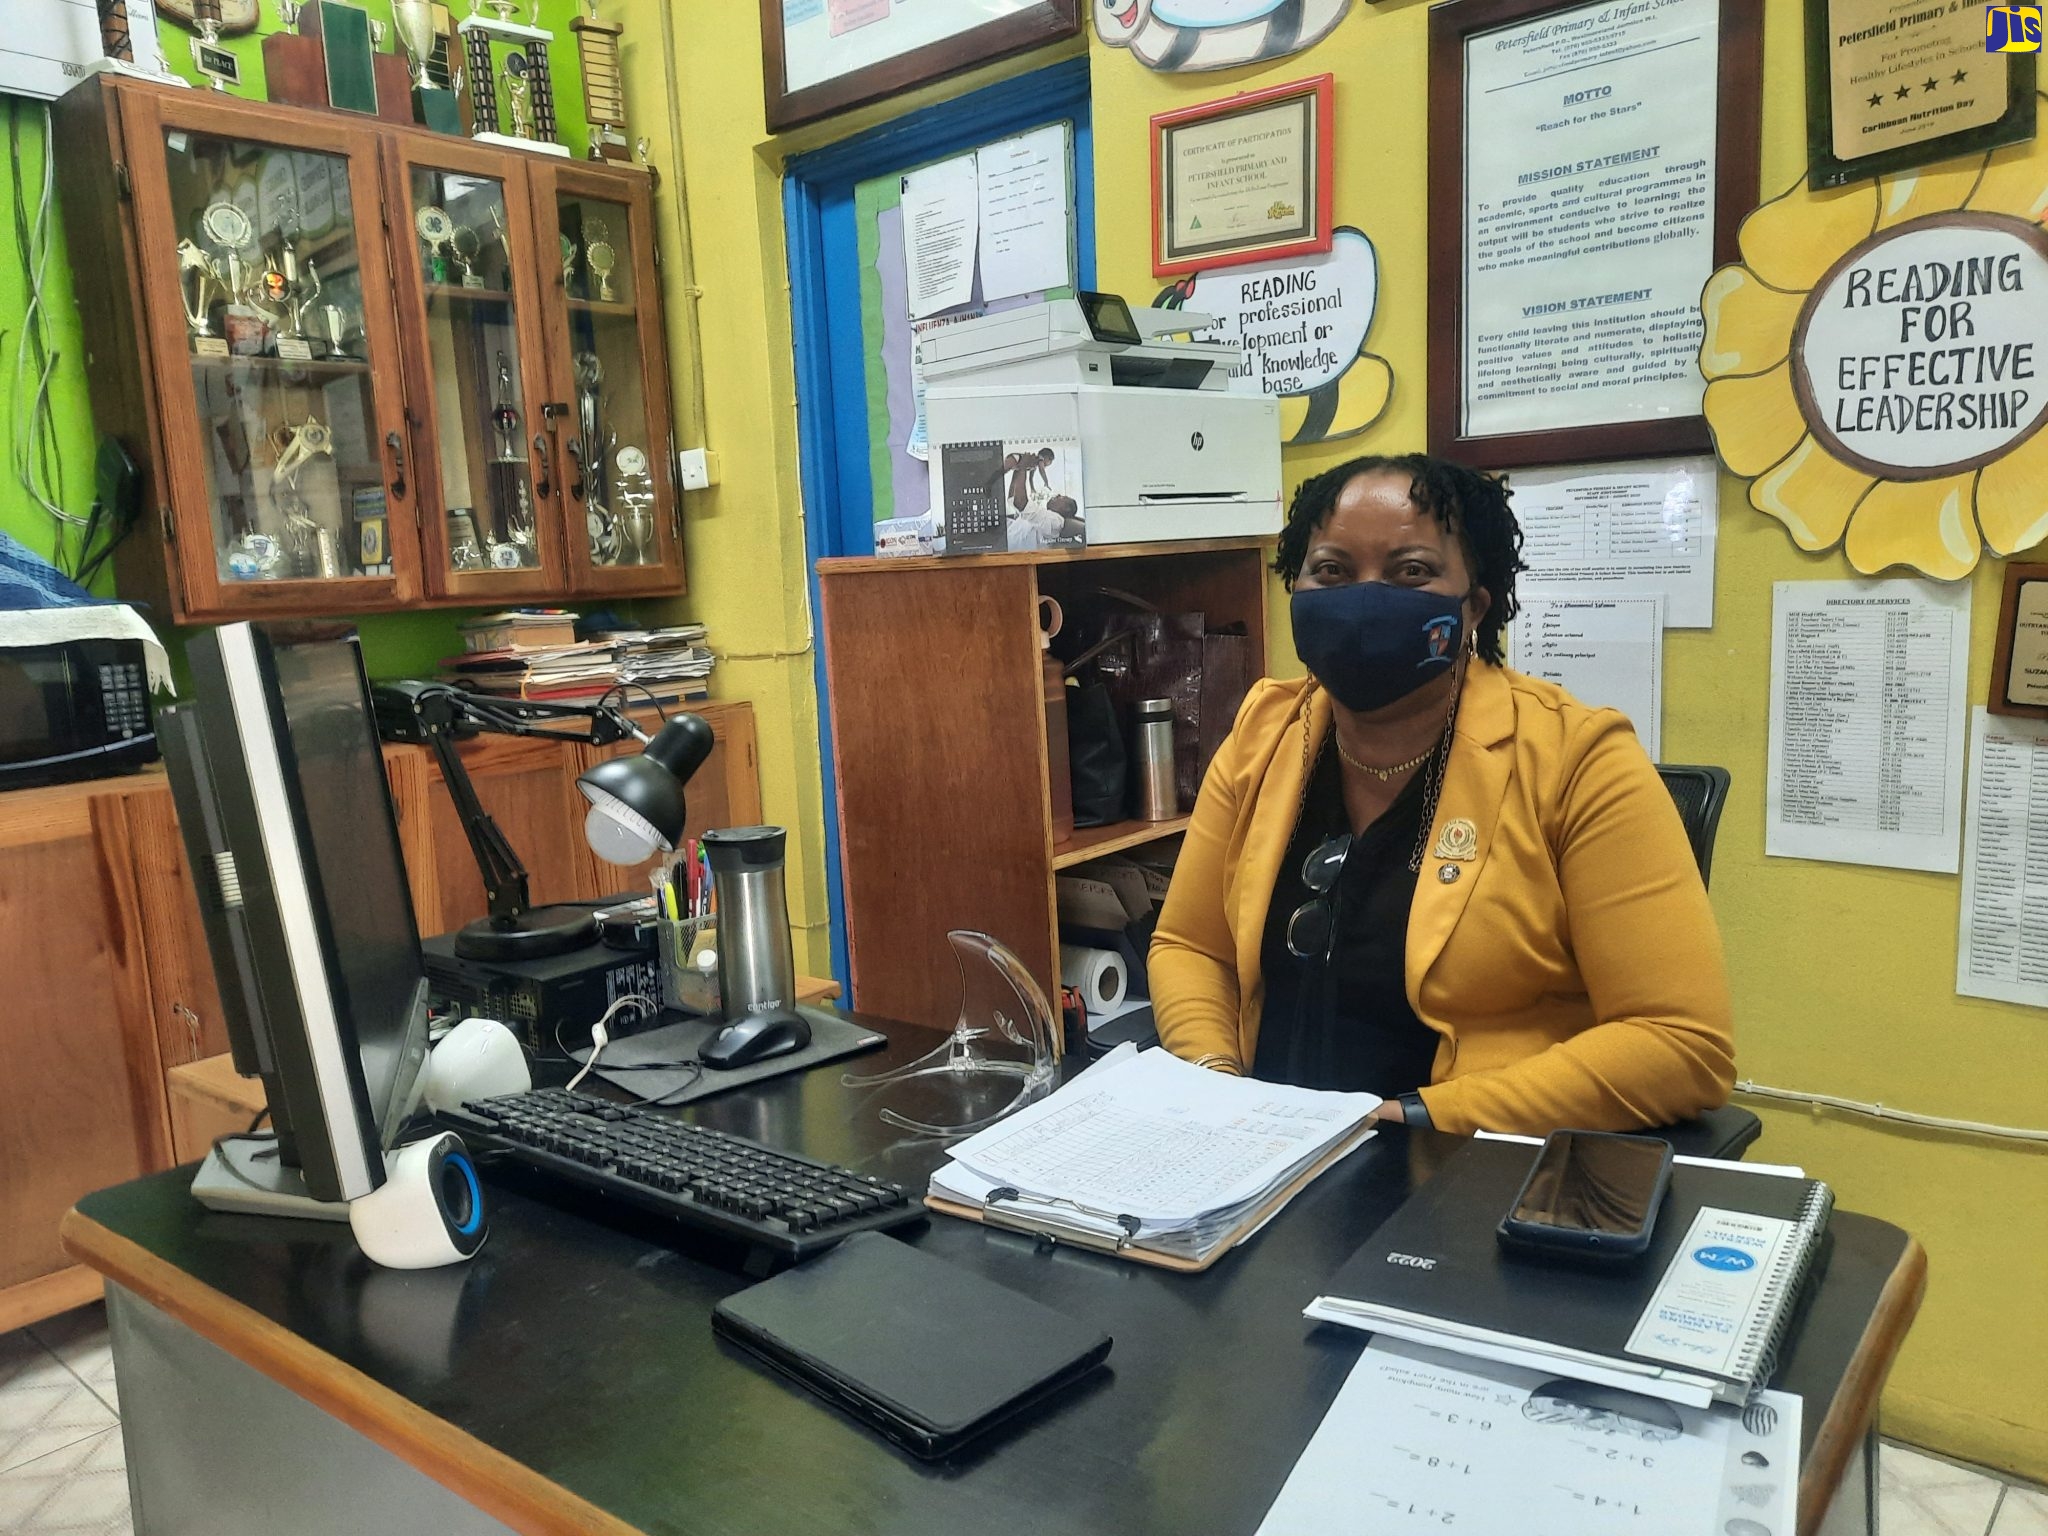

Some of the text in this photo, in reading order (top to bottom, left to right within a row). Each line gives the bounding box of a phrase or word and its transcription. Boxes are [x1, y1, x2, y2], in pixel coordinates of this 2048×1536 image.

[1495, 3, 1649, 51] Petersfield Primary & Infant
[1838, 19, 1896, 47] Petersfield
[1899, 6, 1945, 29] Primary
[1563, 85, 1612, 106] MOTTO
[1573, 116, 1588, 125] for
[1590, 111, 1607, 121] the
[1862, 98, 1975, 134] Caribbean Nutrition Day
[1188, 156, 1287, 182] PETERSFIELD PRIMARY AND
[1518, 146, 1660, 185] MISSION STATEMENT
[1207, 179, 1233, 190] INFANT
[1478, 160, 1706, 211] To provide quality education through
[1529, 202, 1558, 214] sports
[1562, 197, 1580, 207] and
[1584, 188, 1622, 202] cultural
[1626, 176, 1691, 196] programmes
[1495, 215, 1553, 232] environment
[1560, 205, 1610, 220] conducive
[1688, 187, 1705, 195] the
[1478, 236, 1507, 247] output
[1512, 231, 1528, 241] will
[1548, 221, 1590, 235] students
[1595, 217, 1615, 225] who
[1620, 211, 1649, 221] strive
[1669, 200, 1705, 212] realize
[1497, 246, 1521, 257] goals
[1526, 242, 1535, 250] of
[1539, 240, 1554, 248] the
[1559, 232, 1590, 245] school
[1595, 228, 1613, 238] and
[1617, 222, 1658, 234] become
[1663, 213, 1704, 226] citizens
[1478, 264, 1497, 272] who
[1499, 258, 1524, 268] make
[1528, 247, 1580, 263] meaningful
[1583, 237, 1650, 253] contributions
[1241, 270, 1317, 304] READING
[1843, 253, 2023, 309] READING
[1203, 288, 1342, 334] or professional
[1522, 289, 1652, 317] VISION STATEMENT
[1314, 324, 1332, 340] or
[1478, 334, 1503, 342] Every
[1507, 329, 1529, 338] child
[1533, 325, 1567, 335] leaving
[1572, 321, 1590, 329] this
[1594, 314, 1645, 326] institution
[1651, 307, 1685, 318] should
[1901, 301, 1974, 342] FOR
[1478, 341, 1531, 354] functionally
[1535, 336, 1569, 347] literate
[1573, 332, 1591, 342] and
[1478, 356, 1513, 367] positive
[1522, 351, 1552, 360] values
[1561, 346, 1578, 355] and
[1588, 341, 1633, 351] attitudes
[1663, 331, 1703, 342] holistic
[1262, 347, 1338, 374] knowledge
[1478, 368, 1511, 378] lifelong
[1562, 358, 1588, 367] being
[1478, 359, 1687, 389] and aesthetically aware and guided by
[1838, 343, 2034, 391] EFFECTIVE
[1262, 375, 1303, 394] base
[1478, 388, 1535, 400] commitment
[1551, 382, 1578, 393] social
[1581, 380, 1599, 389] and
[1602, 376, 1630, 386] moral
[1836, 389, 2029, 434] LEADERSHIP
[747, 1000, 782, 1012] contigo
[1386, 1252, 1437, 1270] 2022
[1700, 1251, 1747, 1267] W/M
[1659, 1314, 1729, 1334] PLANNING
[1660, 1309, 1733, 1328] CALENDAR
[1441, 1377, 1456, 1386] the
[1448, 1413, 1492, 1430] 6 3
[1428, 1456, 1471, 1474] 1 8
[1606, 1449, 1654, 1468] 3 2
[1408, 1503, 1455, 1524] 2 1
[1594, 1496, 1640, 1515] 1 4
